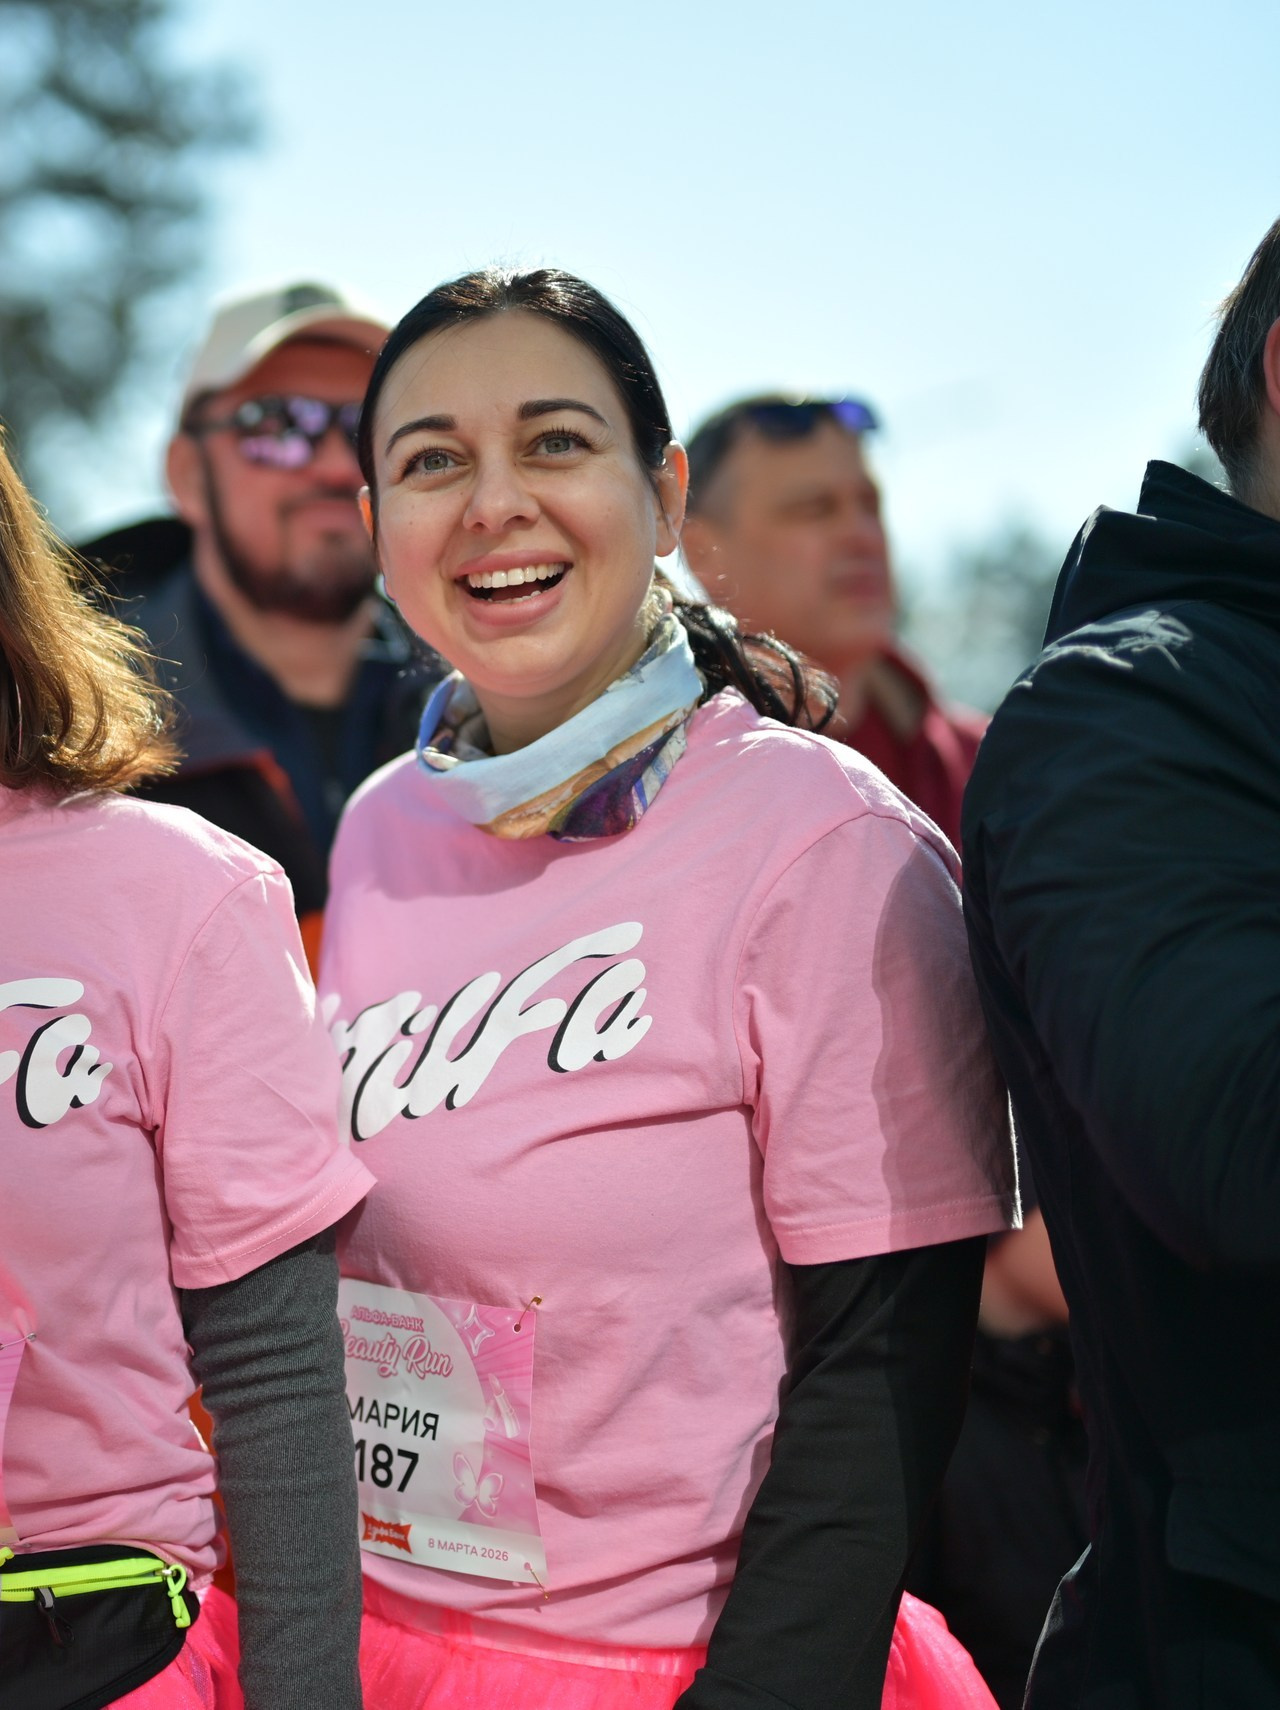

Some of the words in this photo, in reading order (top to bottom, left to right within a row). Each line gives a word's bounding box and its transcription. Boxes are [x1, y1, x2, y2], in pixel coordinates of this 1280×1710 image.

[340, 1318, 401, 1378] eauty
[402, 1334, 454, 1380] Run
[345, 1393, 440, 1441] МАРИЯ
[355, 1438, 419, 1493] 187
[428, 1538, 435, 1548] 8
[437, 1540, 478, 1556] МАРТА
[480, 1547, 509, 1561] 2026
